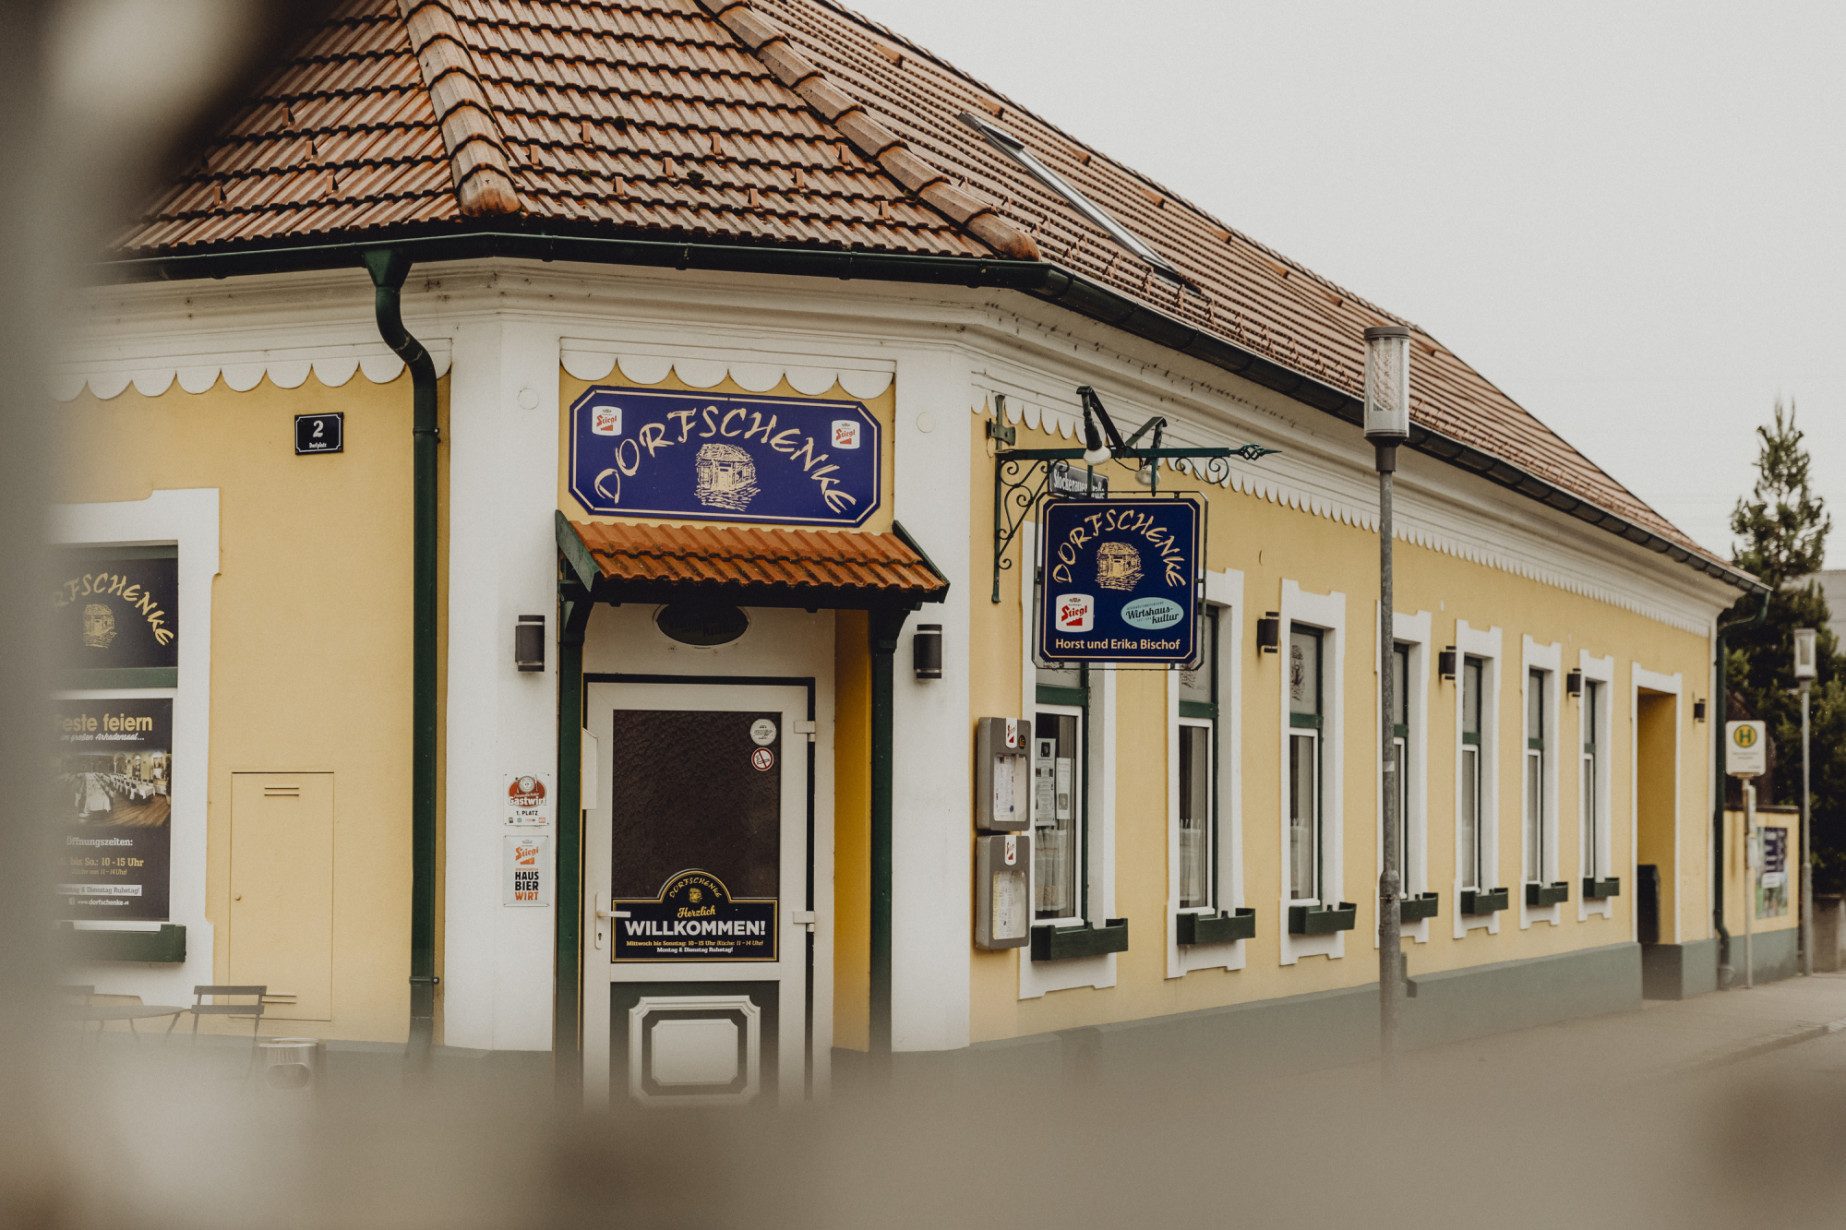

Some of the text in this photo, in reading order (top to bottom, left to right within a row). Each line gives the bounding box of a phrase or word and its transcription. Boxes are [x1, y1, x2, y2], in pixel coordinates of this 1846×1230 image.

[596, 415, 617, 427] Stiegl
[312, 420, 324, 438] 2
[835, 428, 856, 441] Stiegl
[594, 405, 857, 514] DORFSCHENKE
[1052, 509, 1186, 588] DORFSCHENKE
[1061, 604, 1088, 622] Stiegl
[1125, 606, 1174, 620] Wirtshaus-
[1152, 613, 1179, 624] kultur
[1055, 639, 1181, 650] Horst und Erika Bischof
[103, 713, 153, 731] feiern
[1739, 729, 1751, 743] H
[515, 846, 539, 861] Stiegl
[101, 857, 111, 867] 10
[116, 857, 126, 867] 15
[127, 857, 144, 867] Uhr
[515, 871, 539, 880] HAUS
[515, 881, 539, 891] BIER
[669, 877, 722, 898] DORFSCHENKE
[515, 891, 539, 901] WIRT
[677, 905, 717, 918] Herzlich
[625, 920, 766, 936] WILLKOMMEN!
